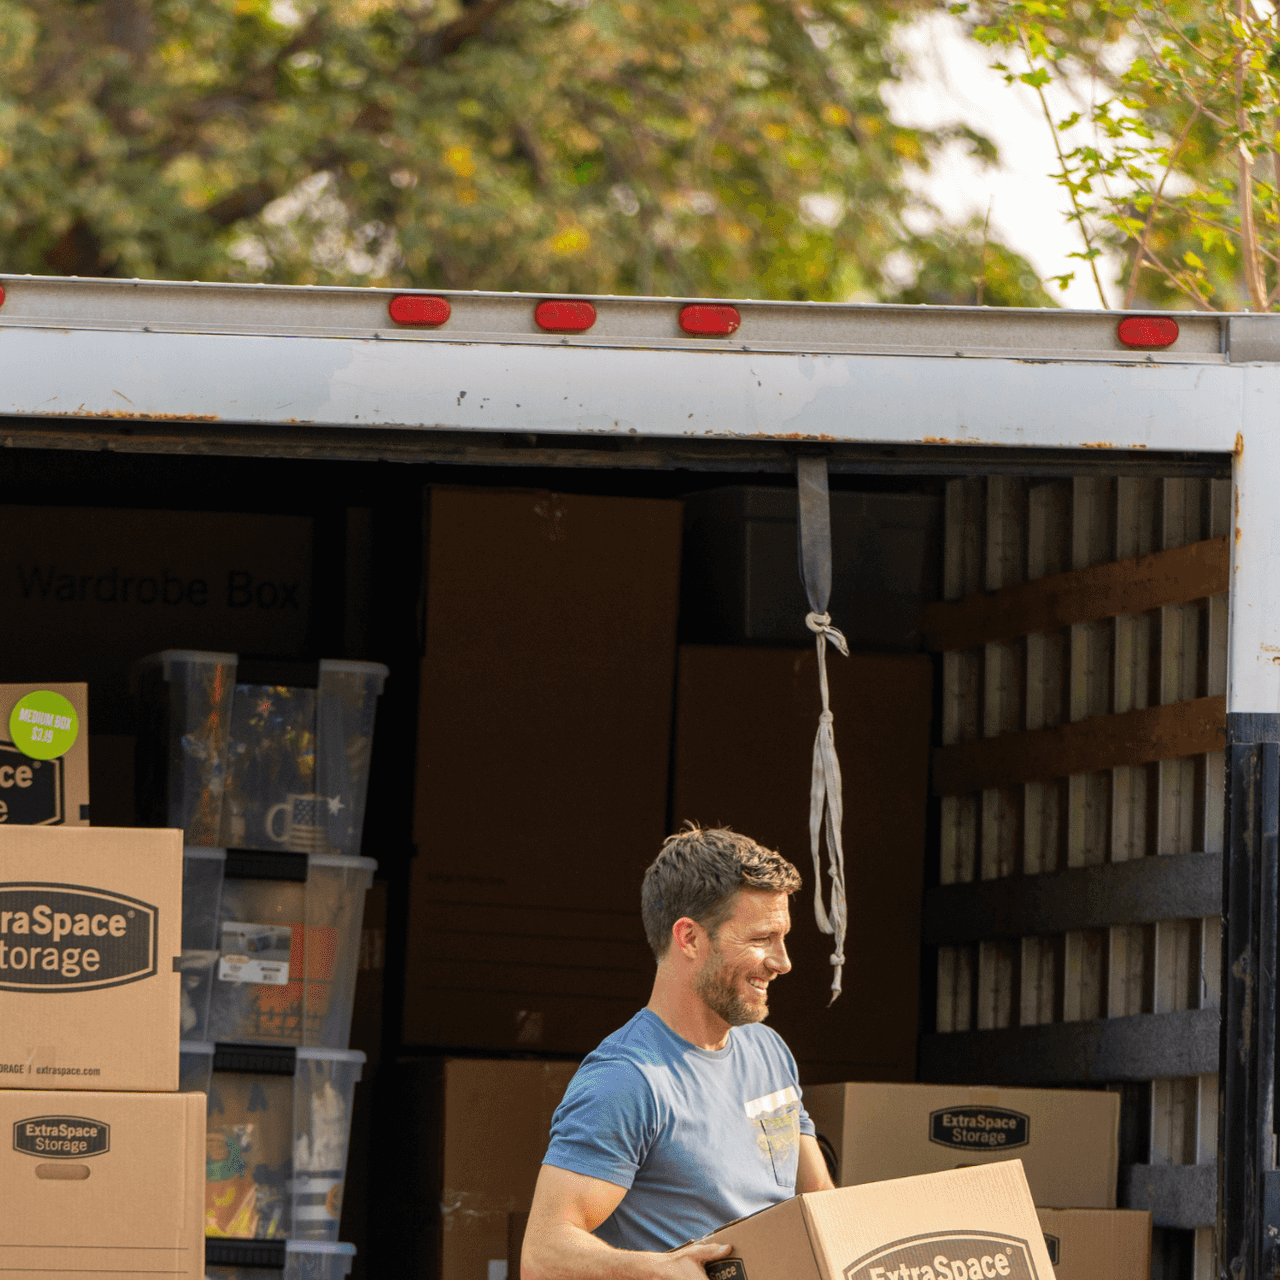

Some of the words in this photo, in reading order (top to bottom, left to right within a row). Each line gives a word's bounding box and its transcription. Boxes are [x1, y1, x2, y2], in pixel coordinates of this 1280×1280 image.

[17, 563, 209, 606] Wardrobe
[227, 569, 300, 611] Box
[19, 708, 54, 727] MEDIUM
[54, 715, 72, 731] BOX
[31, 726, 53, 743] $3.19
[36, 1064, 101, 1077] extraspace.com
[941, 1113, 1017, 1131] ExtraSpace
[25, 1123, 98, 1140] ExtraSpace
[951, 1128, 1006, 1147] Storage
[35, 1137, 87, 1153] Storage
